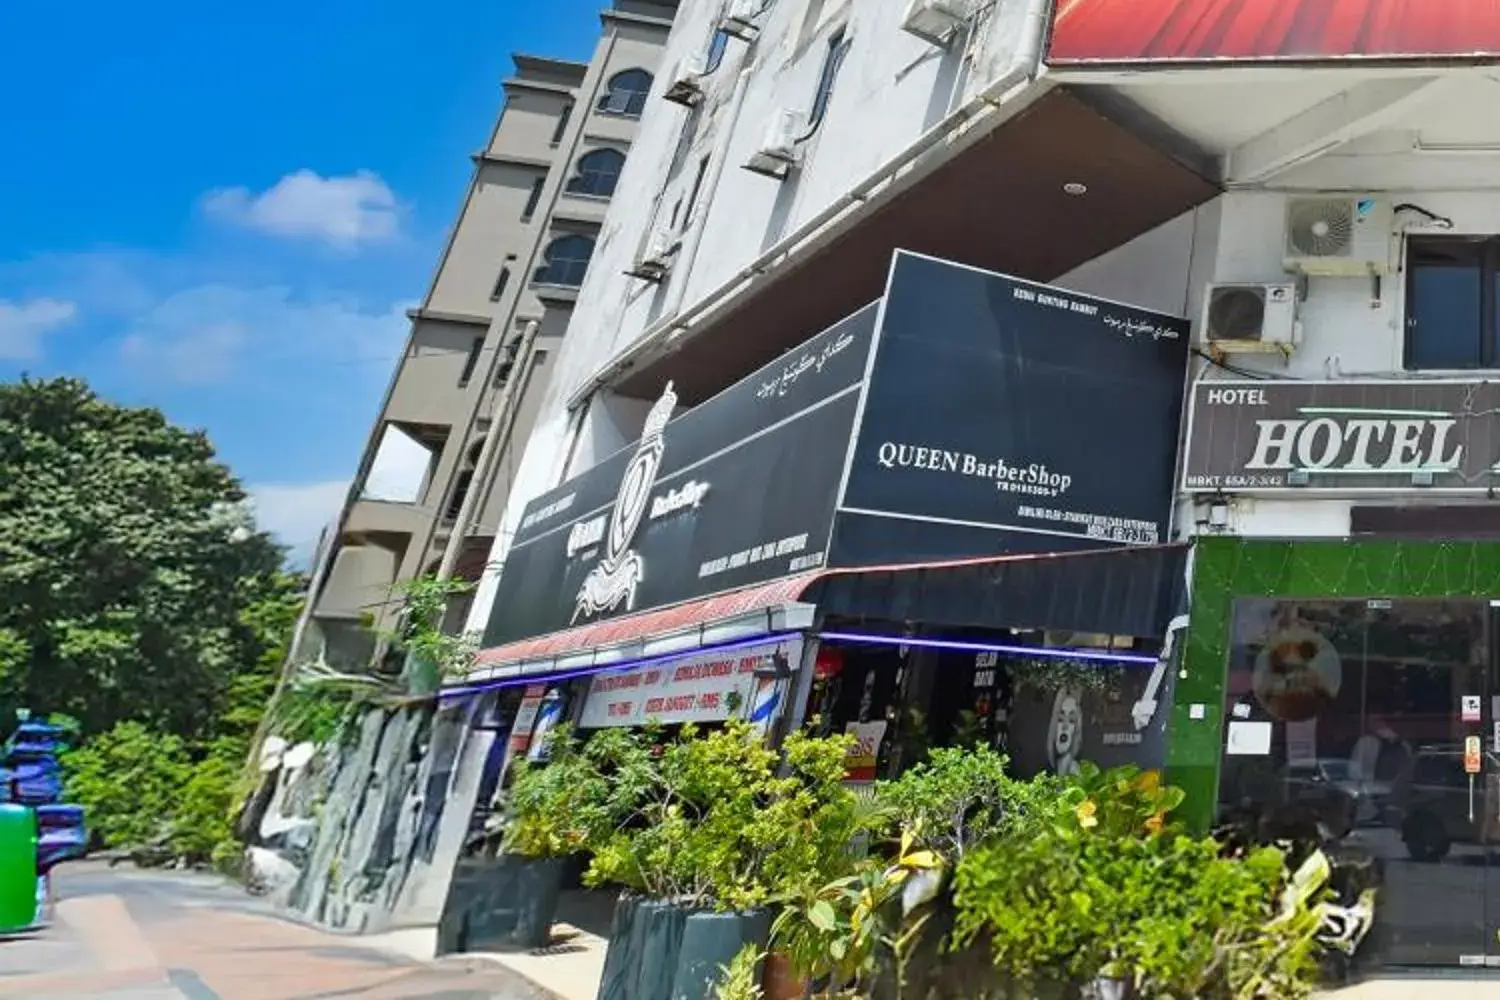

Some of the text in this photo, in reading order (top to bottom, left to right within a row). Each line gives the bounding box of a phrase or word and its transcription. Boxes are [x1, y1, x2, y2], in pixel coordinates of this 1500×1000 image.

[1207, 389, 1269, 405] HOTEL
[879, 441, 1072, 492] QUEEN BarberShop
[1245, 418, 1464, 470] HOTEL
